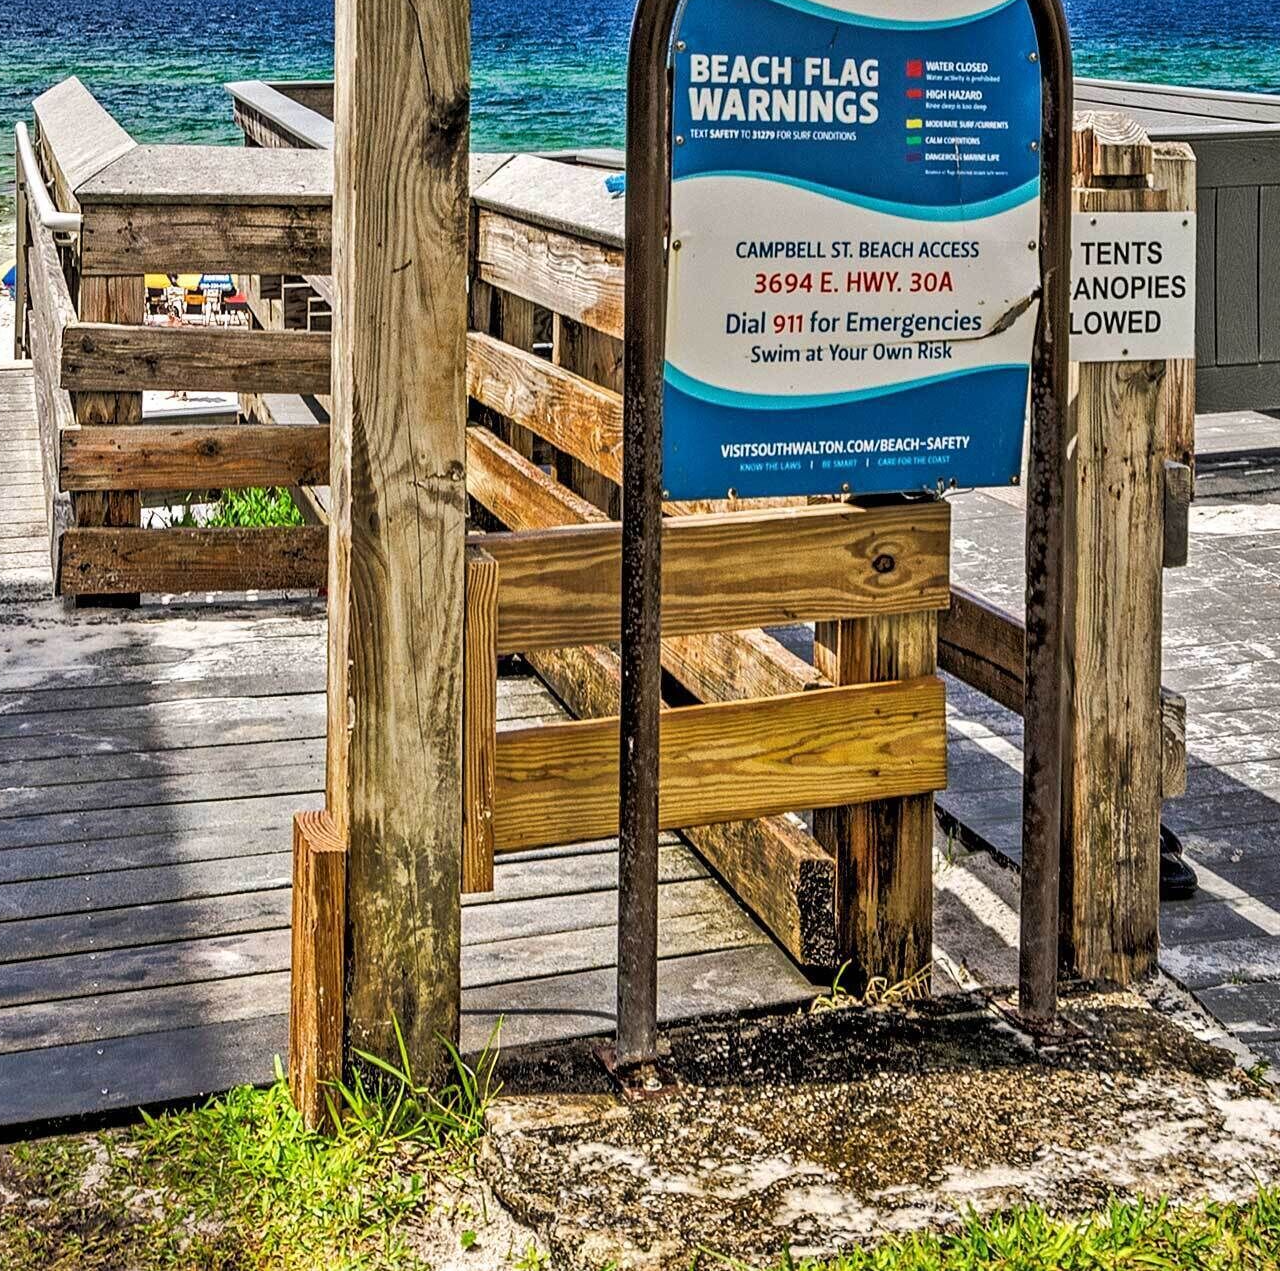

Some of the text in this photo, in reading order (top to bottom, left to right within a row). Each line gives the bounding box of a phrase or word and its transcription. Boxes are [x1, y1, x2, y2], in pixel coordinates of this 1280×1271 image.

[690, 54, 879, 87] BEACH FLAG
[926, 61, 988, 73] WATER CLOSED
[688, 87, 879, 124] WARNINGS
[926, 90, 983, 100] HIGH HAZARD
[690, 129, 856, 141] TEXT SAFETY TO 31279 FOR SURF CONDITIONS
[925, 120, 957, 128] MODERATE
[925, 136, 942, 144] CALM
[963, 153, 986, 161] MARINE
[735, 241, 979, 258] CAMPBELL ST. BEACH ACCESS
[1080, 241, 1163, 265] TENTS
[754, 271, 953, 294] 3694 E. HWY. 30A
[1070, 275, 1186, 300] ANOPIES
[726, 309, 982, 338] Dial 911 for Emergencies
[1069, 310, 1161, 335] LOWED
[751, 340, 952, 363] Swim at Your Own Risk
[721, 436, 970, 458] VISITSOUTHWALTON.COM/BEACH-SAFETY
[740, 455, 950, 472] KNOW THE LAWS BE SMART CARE FOR THE COAST
